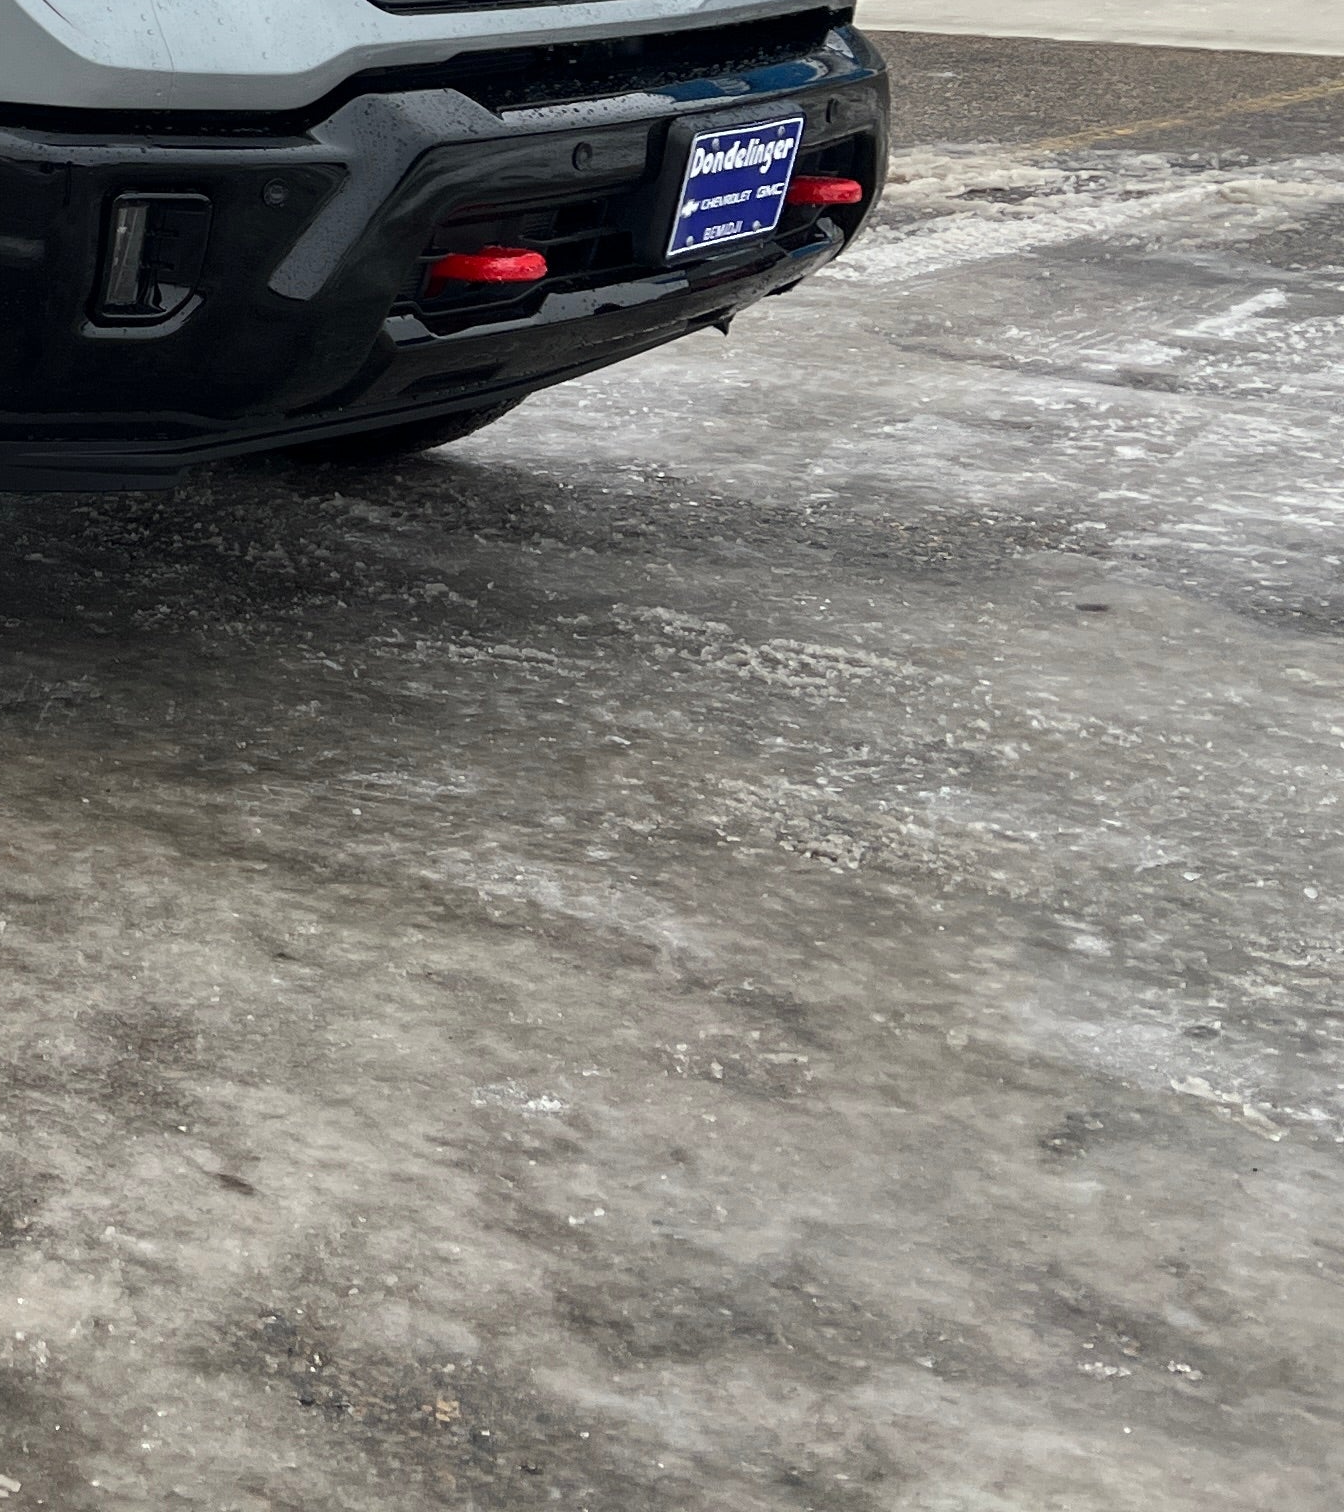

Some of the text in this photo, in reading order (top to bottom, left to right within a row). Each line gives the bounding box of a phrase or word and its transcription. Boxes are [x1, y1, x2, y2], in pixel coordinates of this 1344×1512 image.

[690, 138, 794, 178] Dondelinger
[700, 183, 785, 210] CHEVROLET GMC
[703, 220, 743, 240] BEMIDJI
